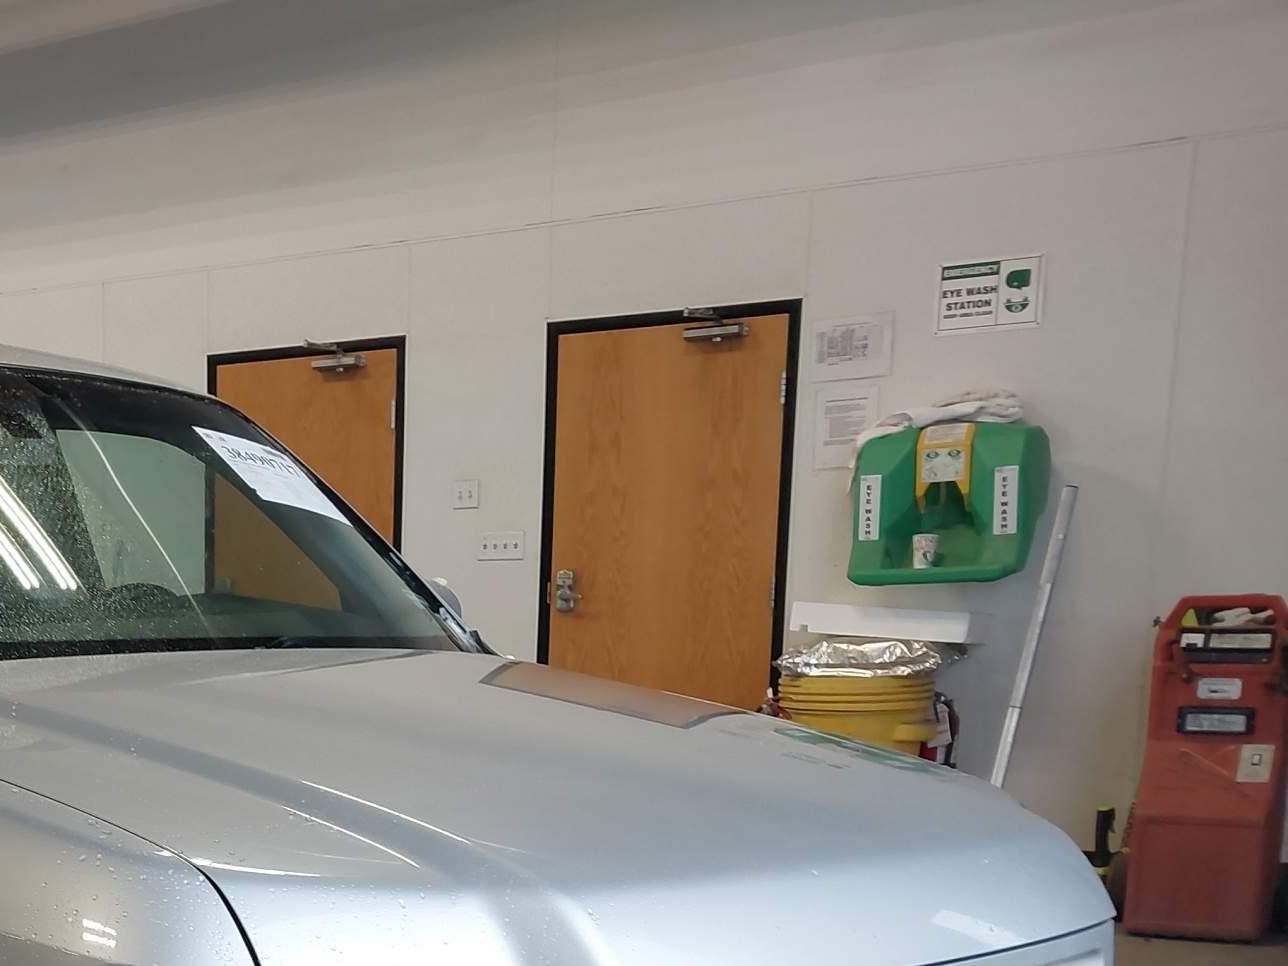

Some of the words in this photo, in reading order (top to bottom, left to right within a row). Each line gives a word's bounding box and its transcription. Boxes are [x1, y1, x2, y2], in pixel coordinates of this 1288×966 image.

[942, 288, 963, 299] EYE
[966, 285, 998, 296] WASH
[945, 299, 992, 312] STATION
[864, 509, 872, 535] WASH
